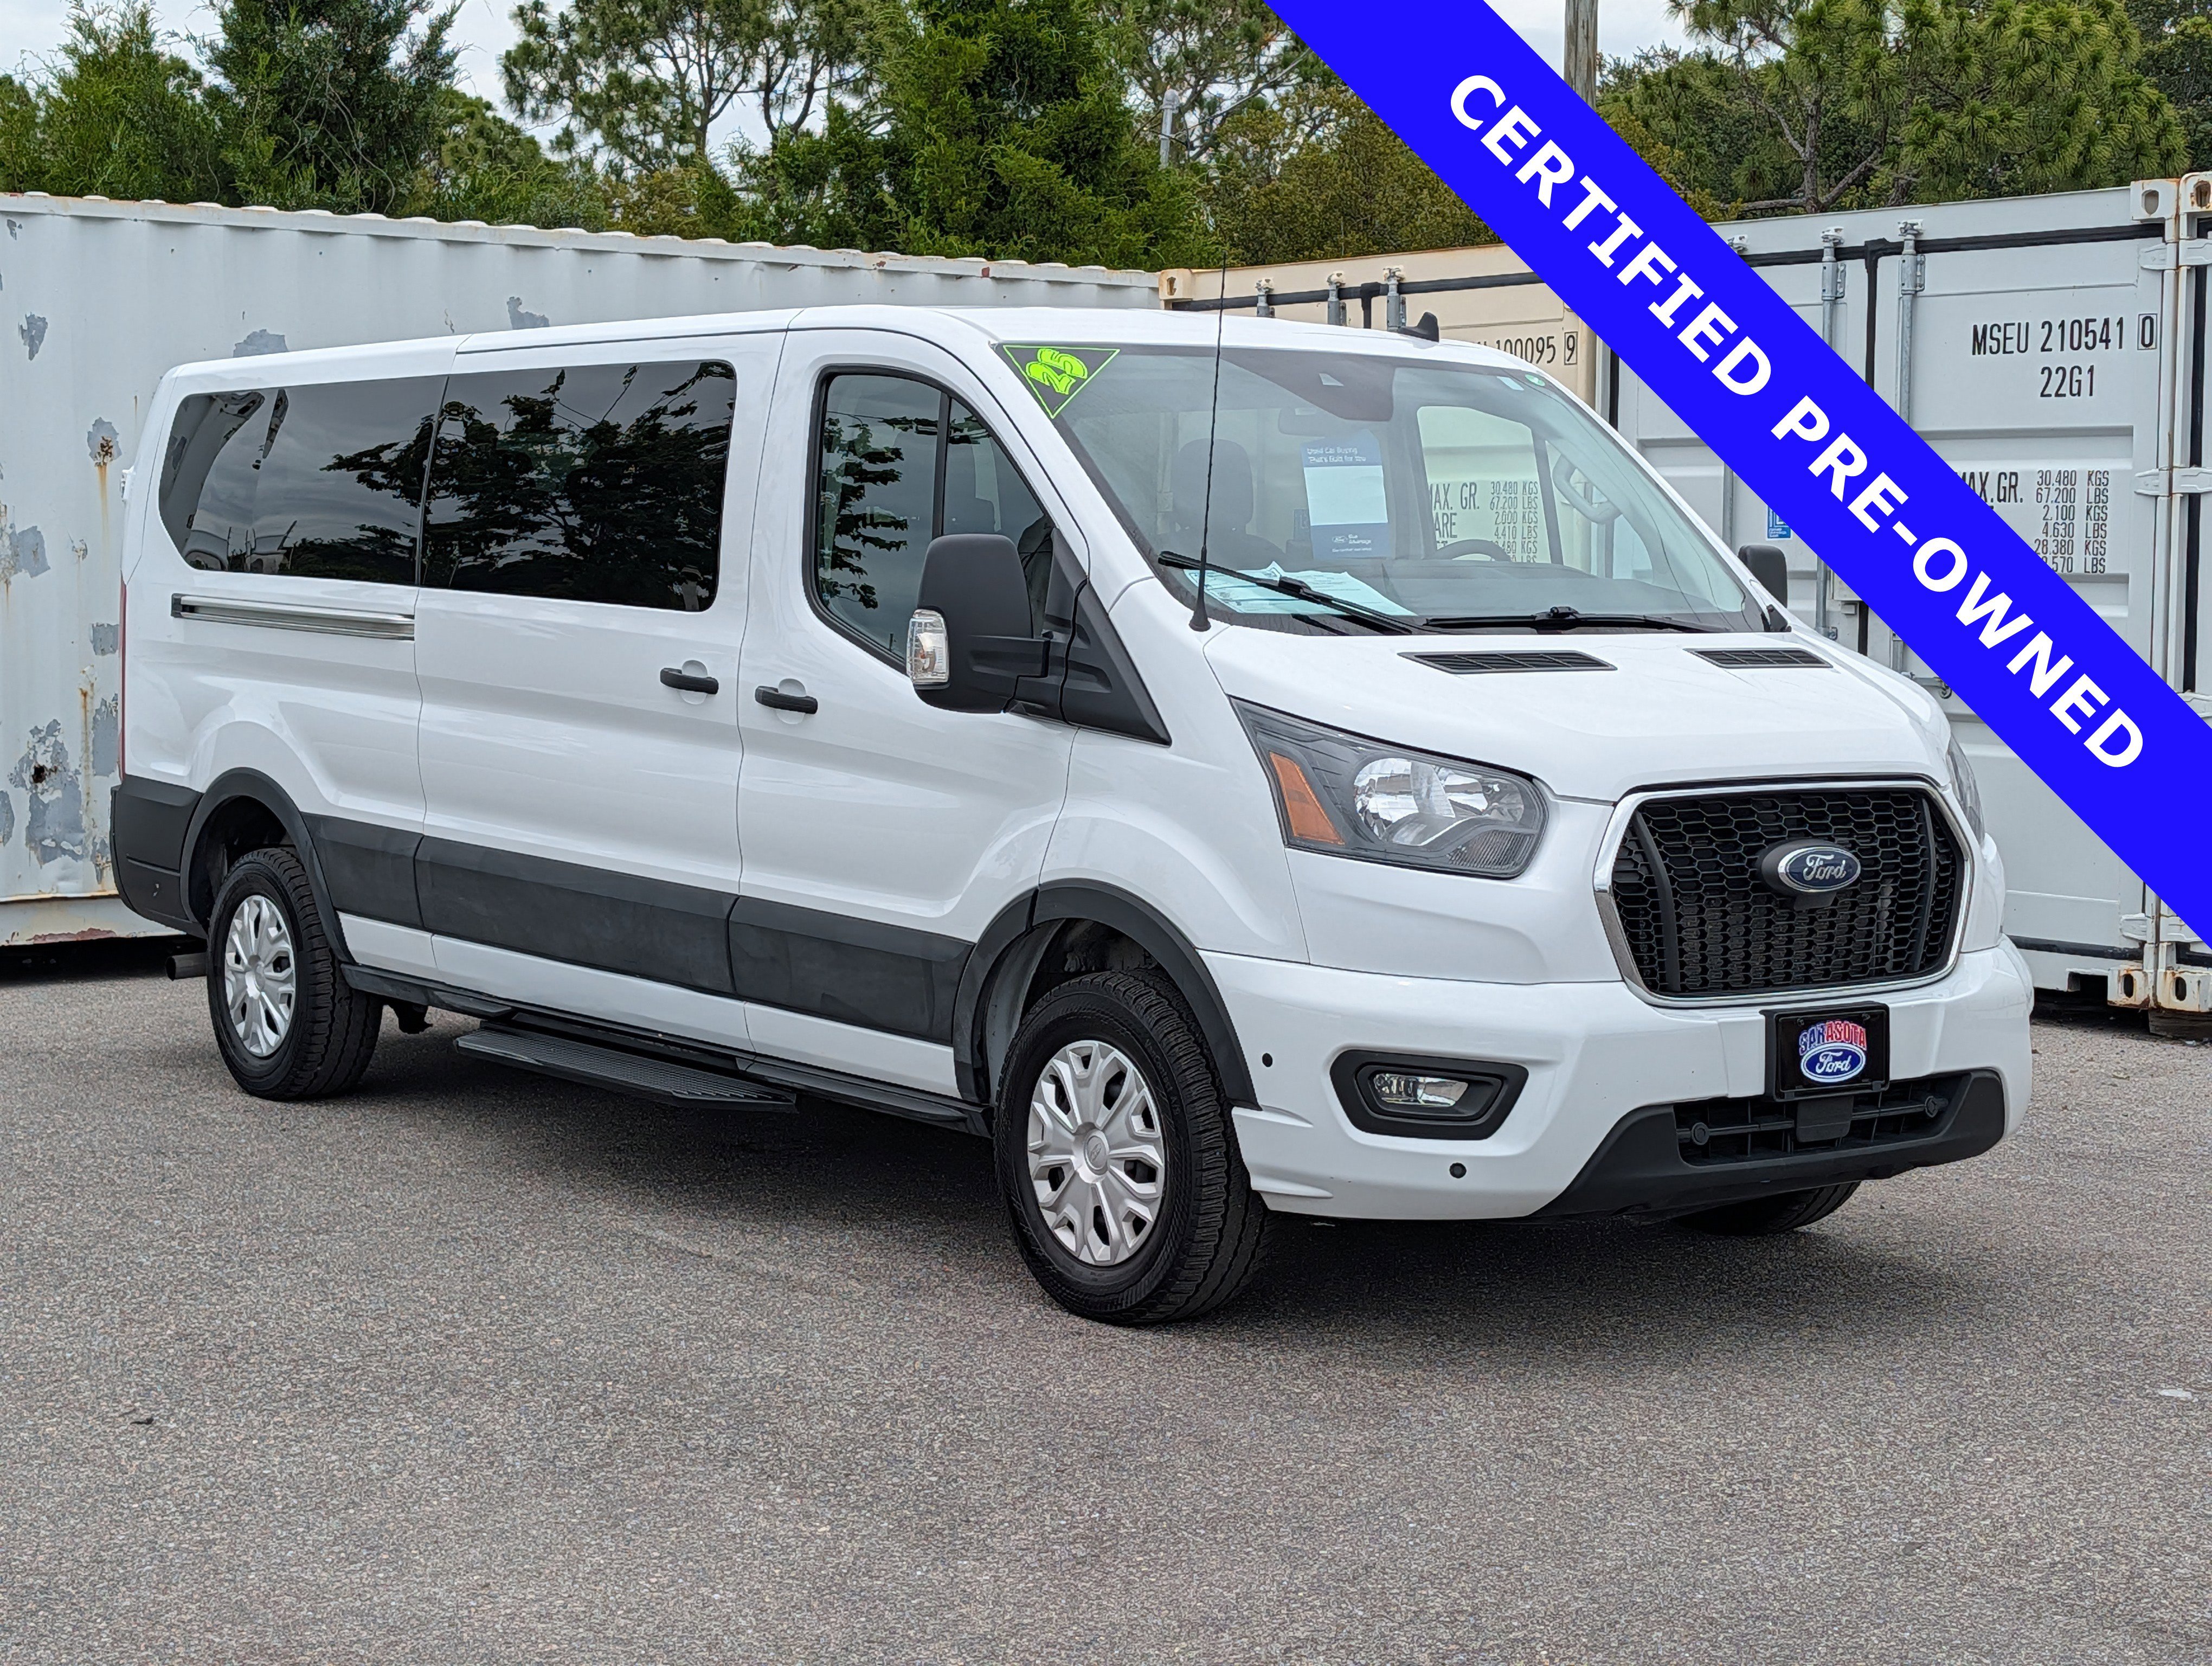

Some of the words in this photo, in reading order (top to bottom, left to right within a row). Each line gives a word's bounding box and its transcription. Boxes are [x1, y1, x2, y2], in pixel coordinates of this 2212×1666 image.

[1971, 322, 2029, 356] MSEU
[2040, 317, 2124, 353] 210541
[2139, 315, 2156, 349] 0
[1025, 348, 1088, 395] 25
[2039, 364, 2096, 398] 22G1
[2037, 470, 2077, 486] 30.480
[2087, 470, 2110, 487] KGS
[1490, 480, 1518, 495] 30.480
[1522, 480, 1538, 495] KGS
[2036, 487, 2076, 504] 67.200
[2086, 488, 2109, 504] LBS
[1490, 496, 1518, 510] 67.200
[1522, 496, 1538, 510] LBS
[1522, 510, 1538, 525] KGS
[2042, 504, 2075, 521] 2.100
[2086, 504, 2108, 522] KGS
[1434, 512, 1457, 539] ARE
[1494, 525, 1517, 540] 4.410
[1521, 525, 1538, 540] LBS
[2042, 522, 2075, 539] 4.630
[2085, 522, 2107, 539] LBS
[1521, 540, 1537, 554] KGS
[2034, 539, 2074, 555] 28.380
[2084, 540, 2106, 556] KGS
[2084, 556, 2106, 574] LBS
[1803, 854, 1847, 881] Ford
[1799, 1020, 1867, 1056] SARASOTA
[1815, 1051, 1851, 1074] Ford
